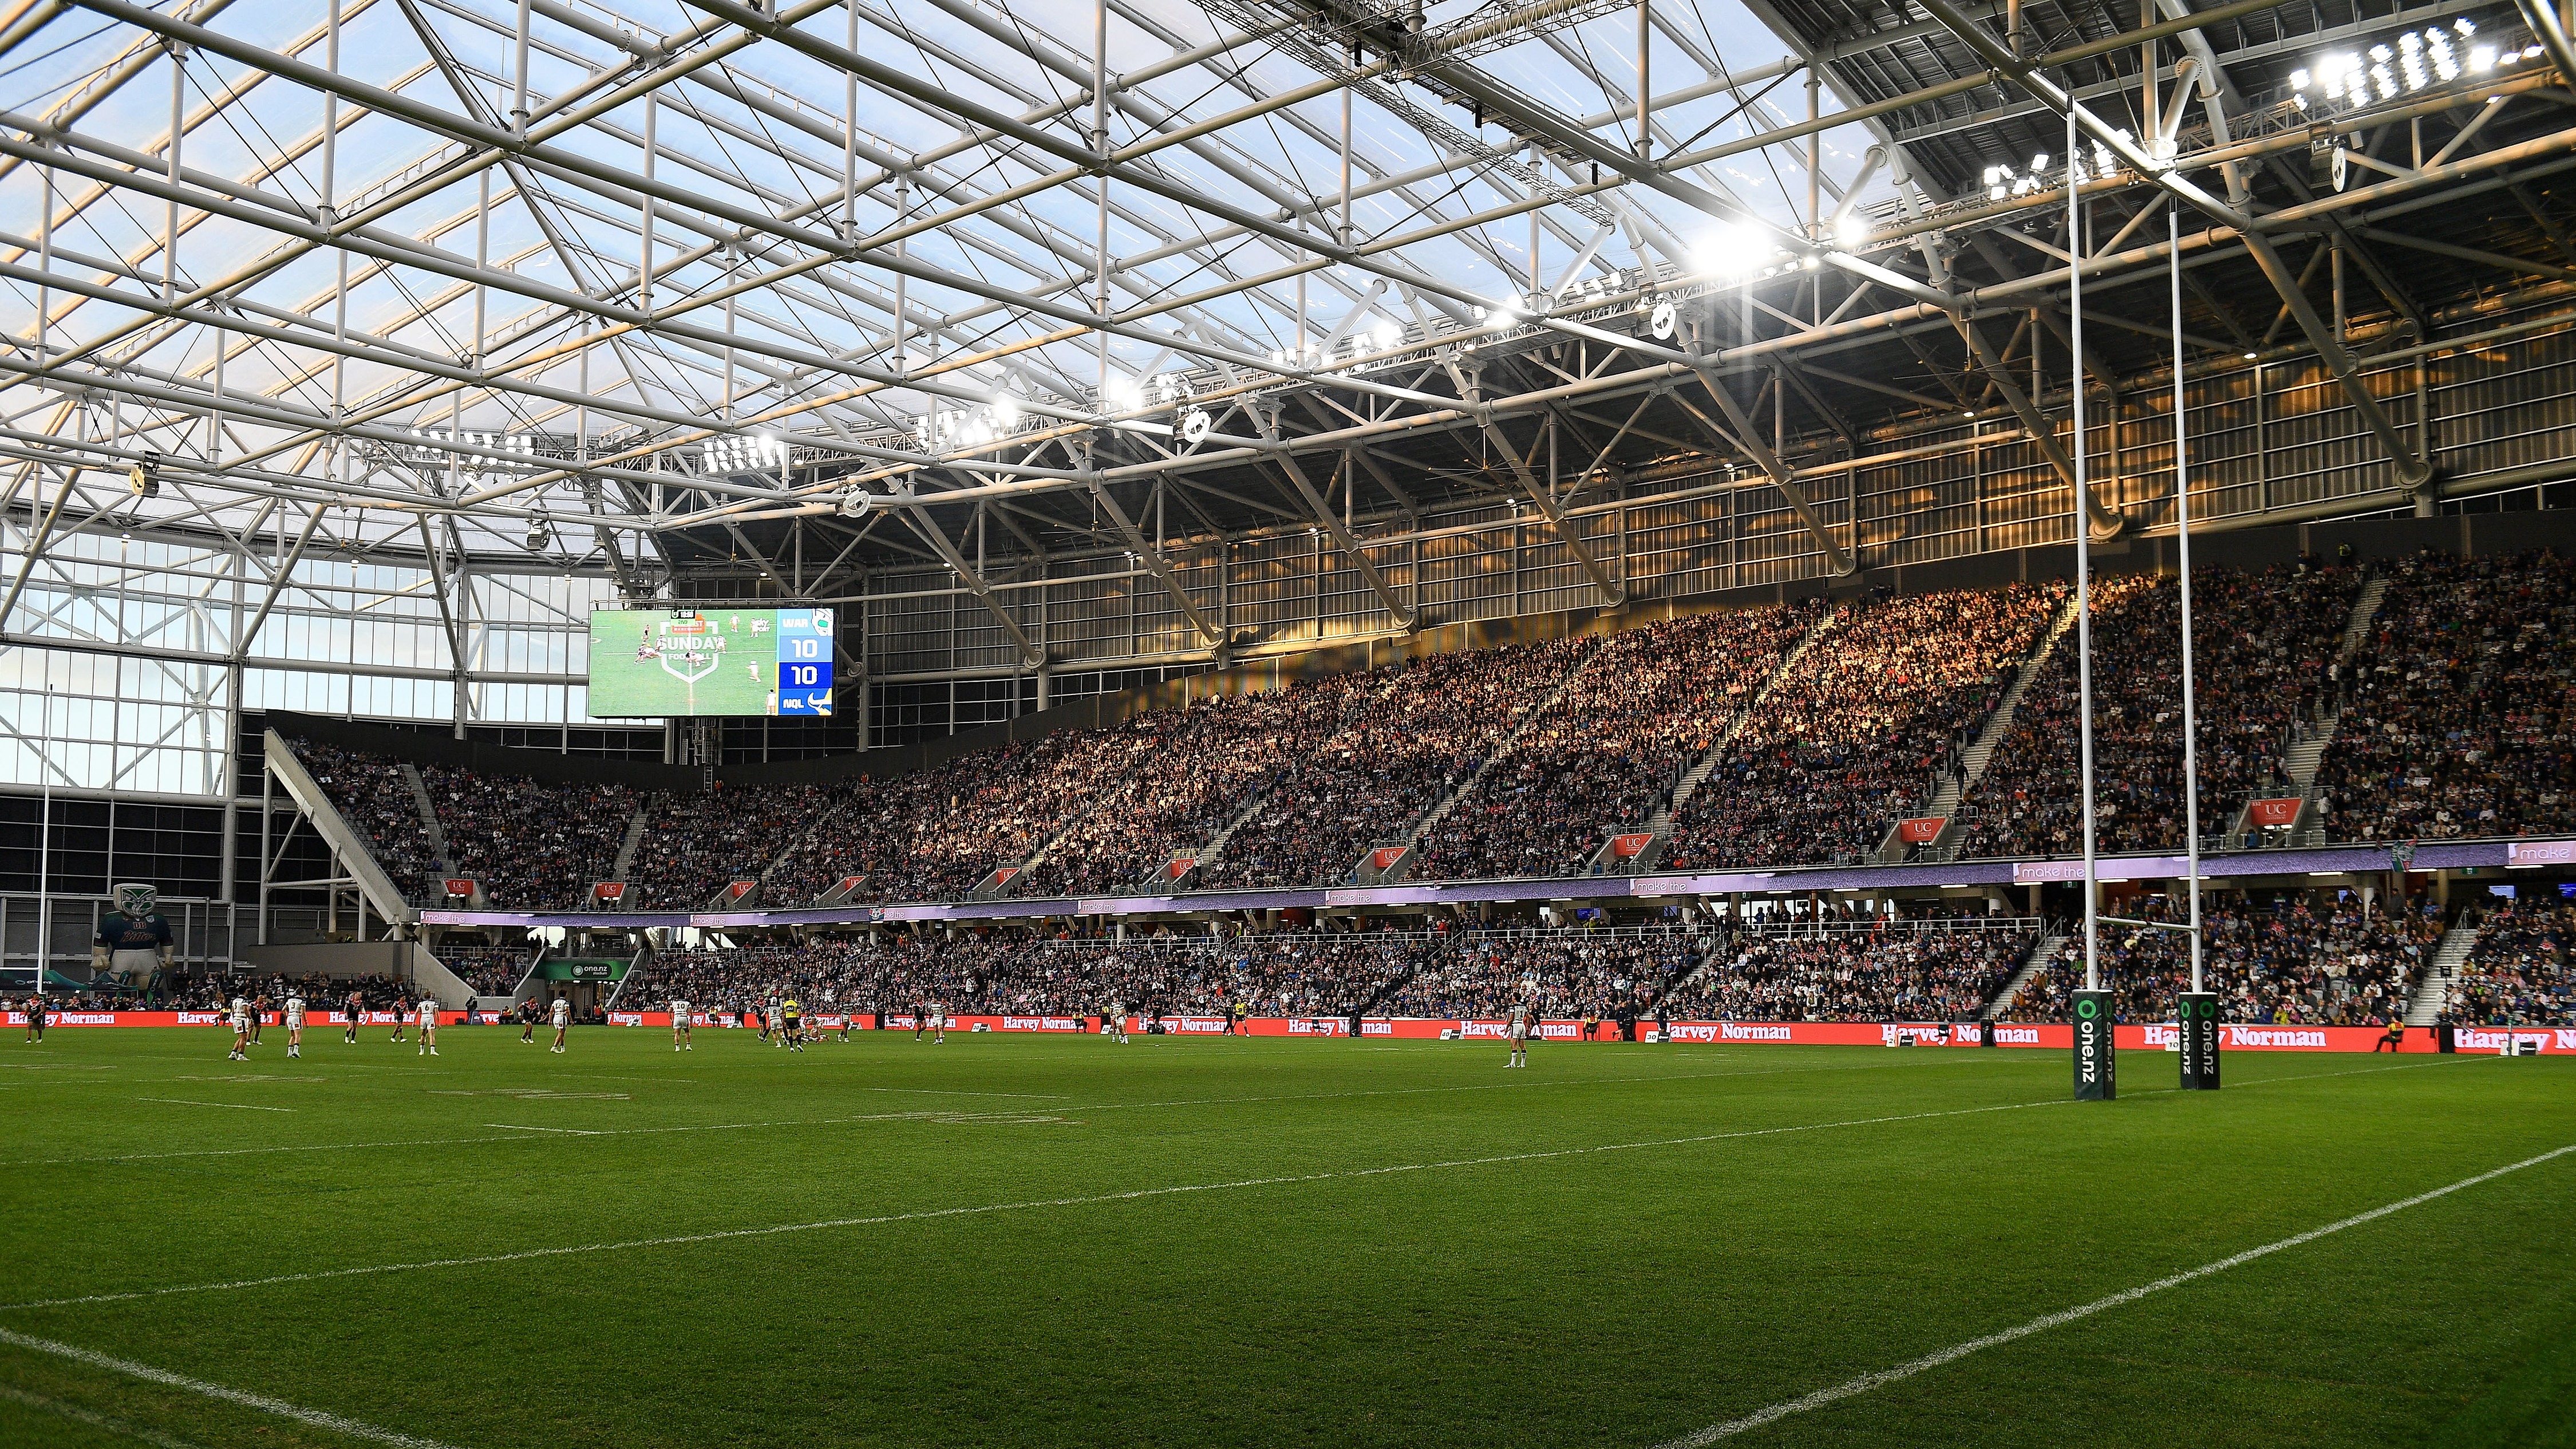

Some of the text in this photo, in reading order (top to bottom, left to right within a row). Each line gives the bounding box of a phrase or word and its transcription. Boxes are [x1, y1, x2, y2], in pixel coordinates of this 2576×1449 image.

[783, 618, 808, 627] WAR
[659, 637, 718, 650] SUNDAY
[791, 639, 818, 658] 10
[791, 666, 817, 685] 10
[783, 698, 804, 709] NQL
[2266, 803, 2287, 814] UC
[1914, 822, 1932, 832] UC
[1626, 838, 1641, 847] UC
[1384, 851, 1397, 859] UC
[2520, 846, 2570, 860] make
[1179, 862, 1191, 870] UC
[2022, 865, 2085, 878] make the
[1003, 871, 1013, 879] UC
[1637, 881, 1686, 892] make the
[1331, 893, 1371, 903] make the
[1082, 902, 1115, 911] make the
[452, 915, 466, 923] the
[895, 910, 904, 918] the
[7, 1012, 115, 1026] Haey Norman
[177, 1012, 220, 1026] Harve
[329, 1012, 416, 1025] Haey Noran
[705, 1013, 736, 1024] Nman
[1003, 1016, 1084, 1031] Harvey Norma
[1181, 1018, 1229, 1032] Norman
[1337, 1020, 1392, 1035] Nman
[1460, 1021, 1511, 1039] Harvey
[1721, 1023, 1791, 1040] Norman
[1956, 1025, 2039, 1043] Noman
[2230, 1027, 2326, 1047] Norman
[2453, 1029, 2551, 1052] Harvey
[2081, 1021, 2095, 1083] one.nz
[2182, 1020, 2191, 1075] one.nz
[2202, 1020, 2214, 1075] one.nz
